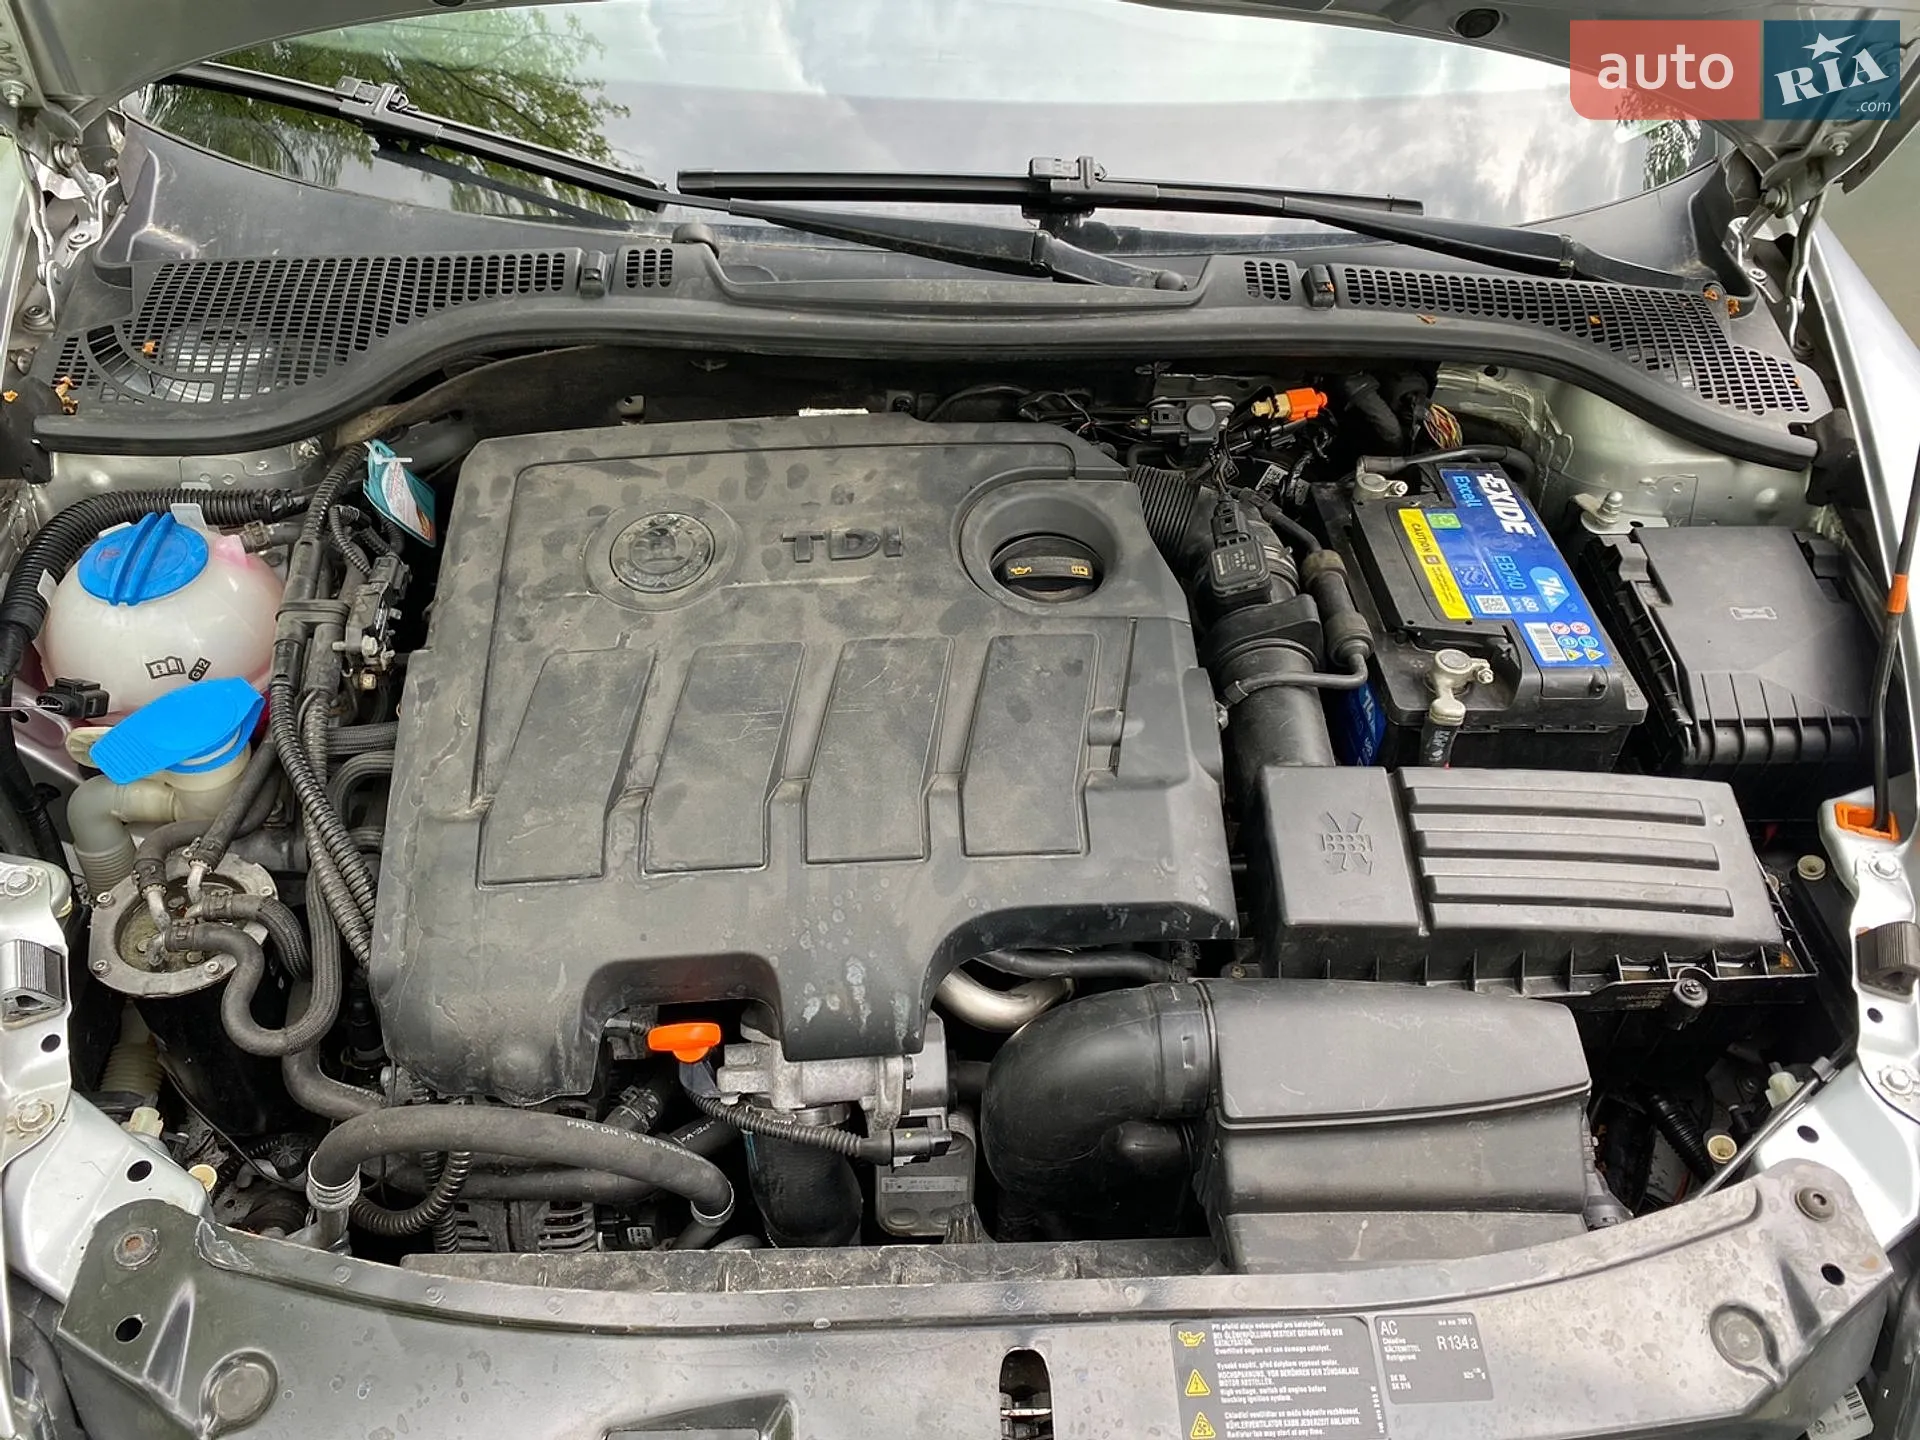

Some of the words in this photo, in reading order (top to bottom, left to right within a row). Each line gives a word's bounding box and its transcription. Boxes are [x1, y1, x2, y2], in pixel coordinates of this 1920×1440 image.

[1452, 475, 1483, 508] Excell
[1477, 474, 1537, 537] EXIDE
[782, 517, 903, 563] TDI
[1411, 522, 1433, 554] CAUTION
[1494, 555, 1527, 590] EB740
[191, 660, 209, 679] G12
[1380, 1320, 1398, 1335] AC
